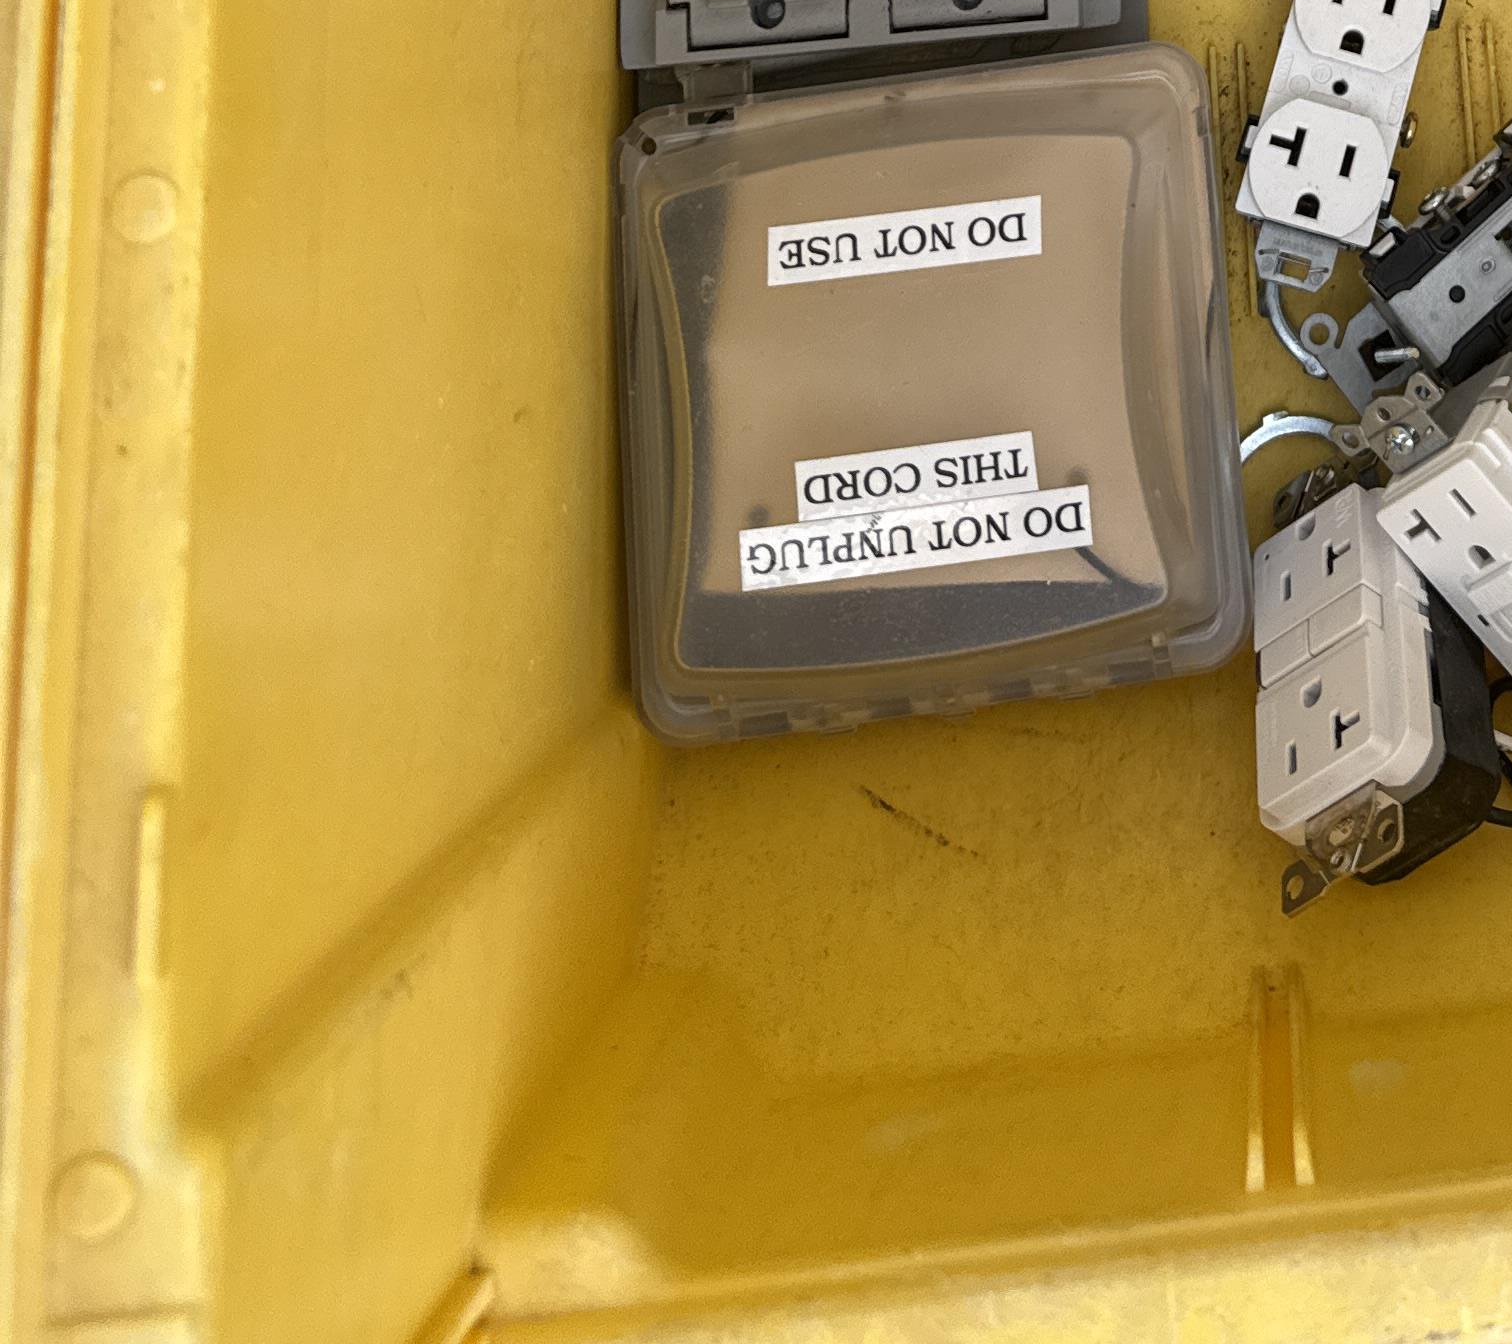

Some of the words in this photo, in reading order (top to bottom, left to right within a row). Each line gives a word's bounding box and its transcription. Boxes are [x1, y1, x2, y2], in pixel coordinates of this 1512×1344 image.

[873, 221, 957, 259] NOT
[967, 212, 1028, 248] DO
[778, 233, 863, 270] USE
[803, 461, 922, 505] CORD
[933, 448, 1029, 489] THIS
[928, 511, 1013, 552] NOT
[1023, 501, 1086, 538] DO
[746, 526, 917, 575] UNPLUG
